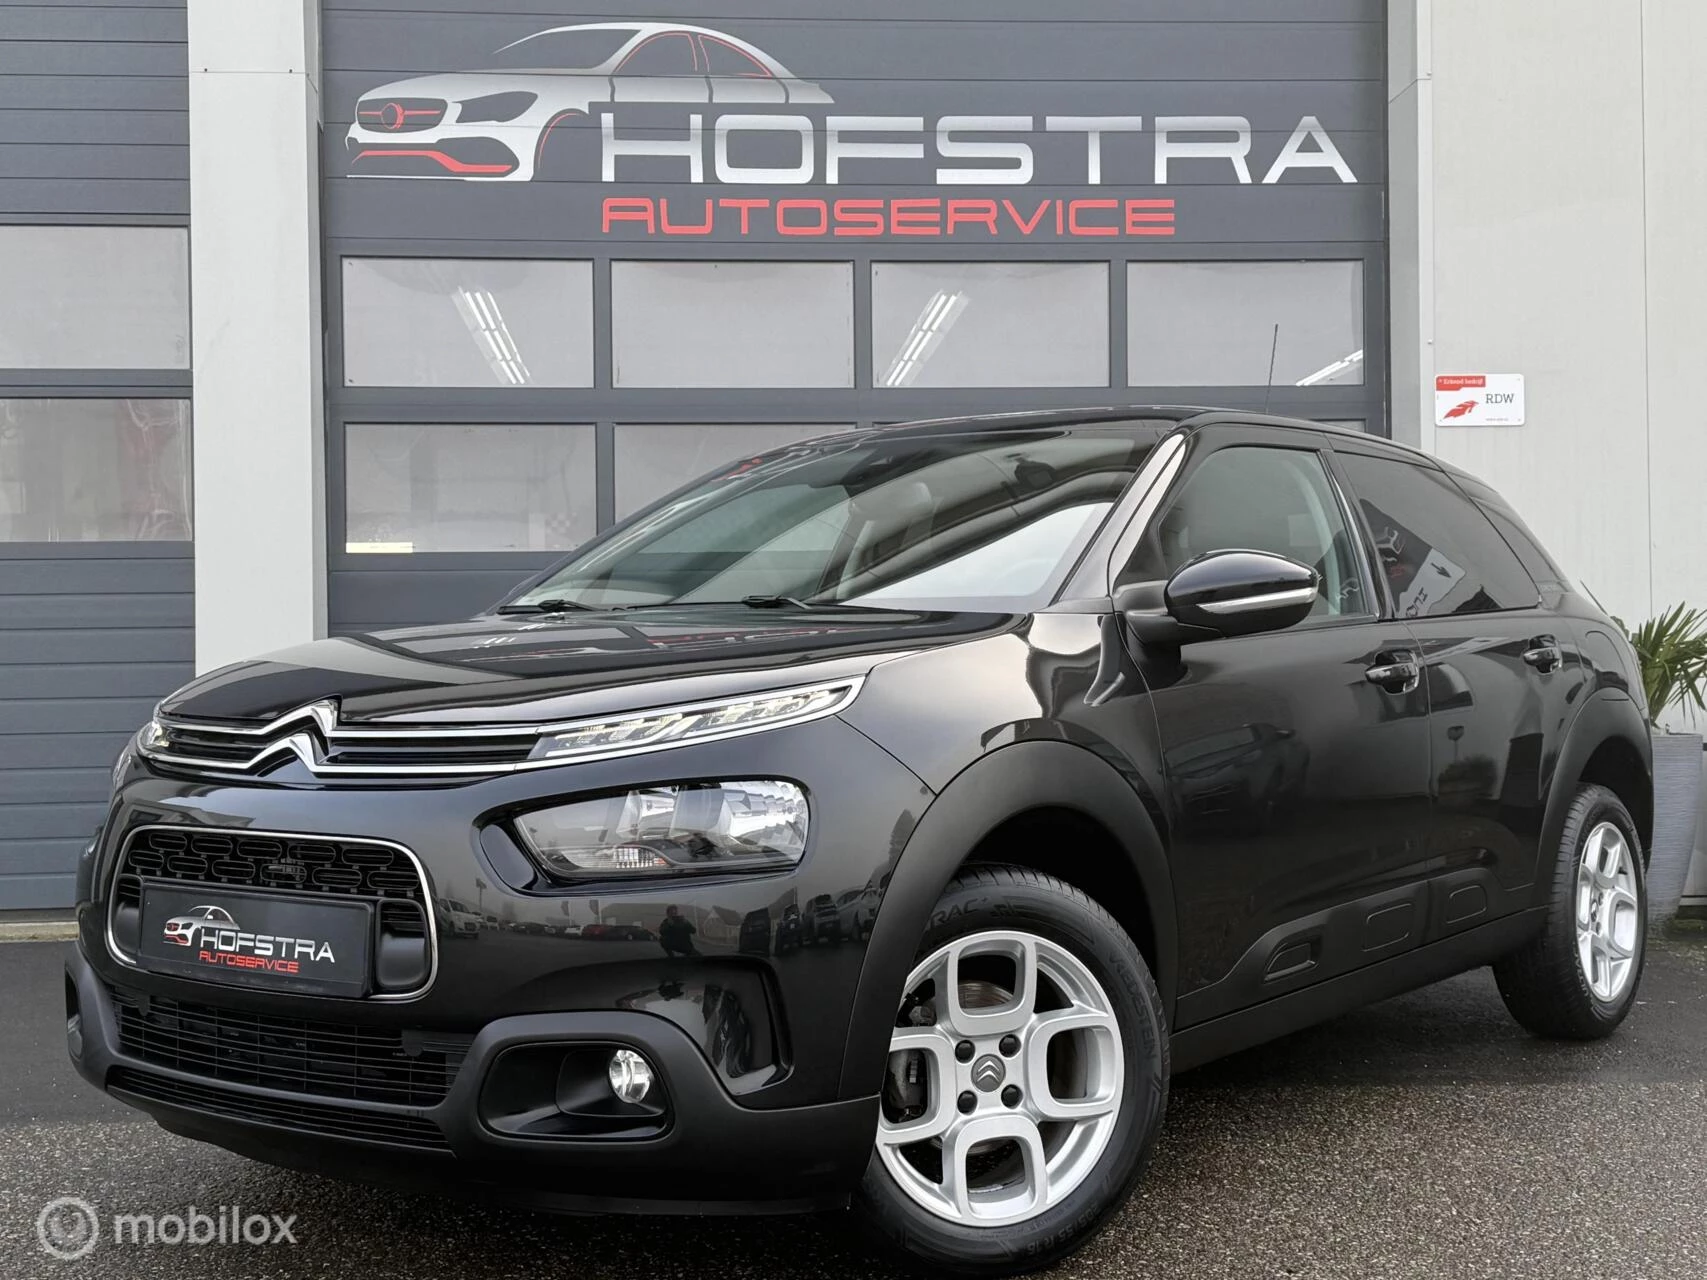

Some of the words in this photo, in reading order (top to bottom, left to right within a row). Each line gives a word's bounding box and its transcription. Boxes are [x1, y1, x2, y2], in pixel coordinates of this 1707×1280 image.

[601, 113, 1358, 185] HOFSTRA
[602, 197, 1176, 237] AUTOSERVICE
[1485, 393, 1514, 404] RDW
[198, 950, 299, 973] AUTOSERVICE
[200, 928, 335, 963] HOFSTRA
